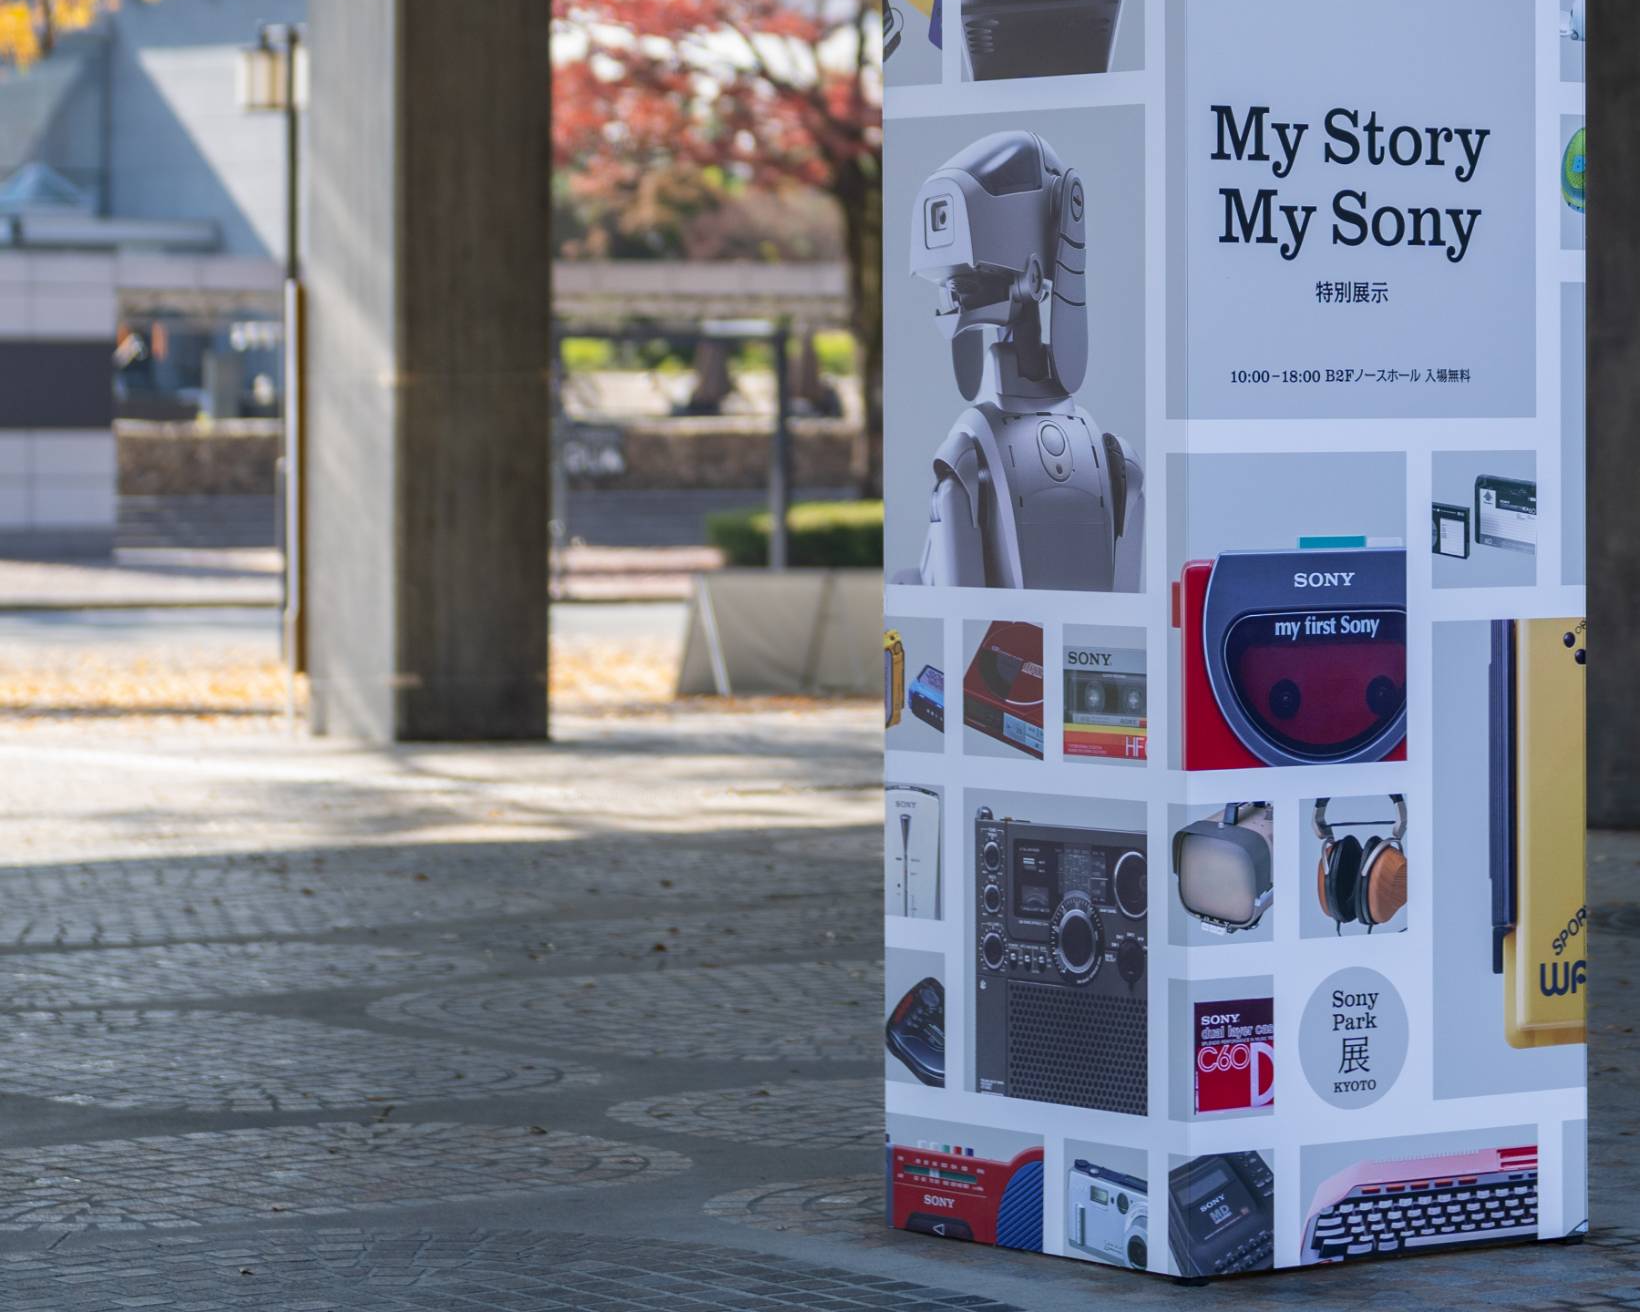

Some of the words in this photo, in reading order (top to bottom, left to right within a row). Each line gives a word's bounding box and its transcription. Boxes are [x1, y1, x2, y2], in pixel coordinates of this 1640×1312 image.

[1210, 104, 1309, 178] My
[1324, 108, 1490, 182] Story
[1218, 188, 1317, 261] My
[1332, 189, 1482, 263] Sony
[1315, 280, 1389, 304] 特別展示
[1425, 368, 1471, 383] 入場無料
[1293, 572, 1355, 588] SONY
[1274, 620, 1301, 641] my
[1304, 615, 1337, 635] first
[1340, 615, 1380, 639] Sony
[1068, 651, 1112, 666] SONY
[1125, 735, 1147, 758] HF
[1332, 989, 1380, 1010] Sony
[1201, 1014, 1240, 1026] SONY
[1332, 1011, 1378, 1031] Park
[1197, 1043, 1251, 1073] C60
[1338, 1035, 1371, 1074] 展
[1333, 1079, 1376, 1093] KYOTO
[923, 1193, 957, 1209] SONY
[1200, 1193, 1225, 1213] SONY
